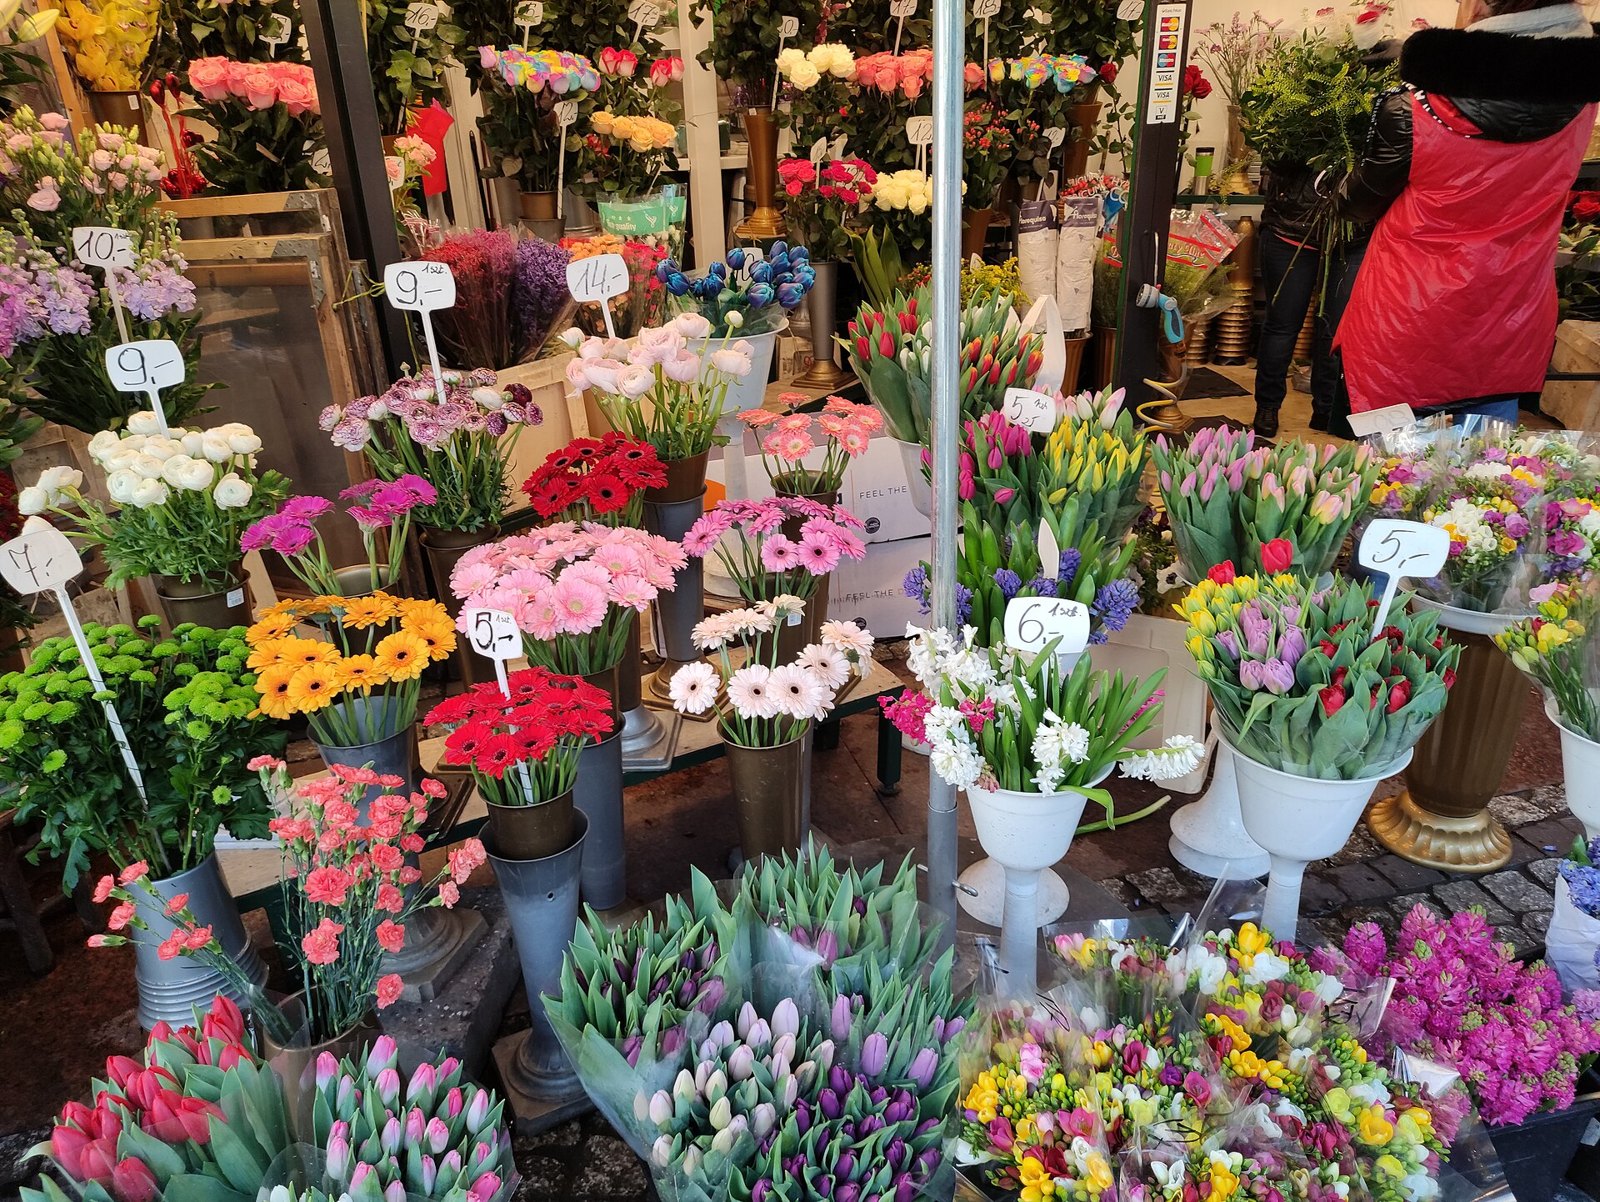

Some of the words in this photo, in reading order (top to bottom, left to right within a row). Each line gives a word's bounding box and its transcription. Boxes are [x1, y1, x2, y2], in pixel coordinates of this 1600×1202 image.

[396, 270, 442, 305] 9,-
[574, 259, 622, 295] 14,-
[118, 347, 174, 385] 9,-
[859, 488, 884, 499] FEEL
[888, 485, 907, 495] THE
[1372, 529, 1430, 568] 5,-
[873, 587, 893, 598] THE
